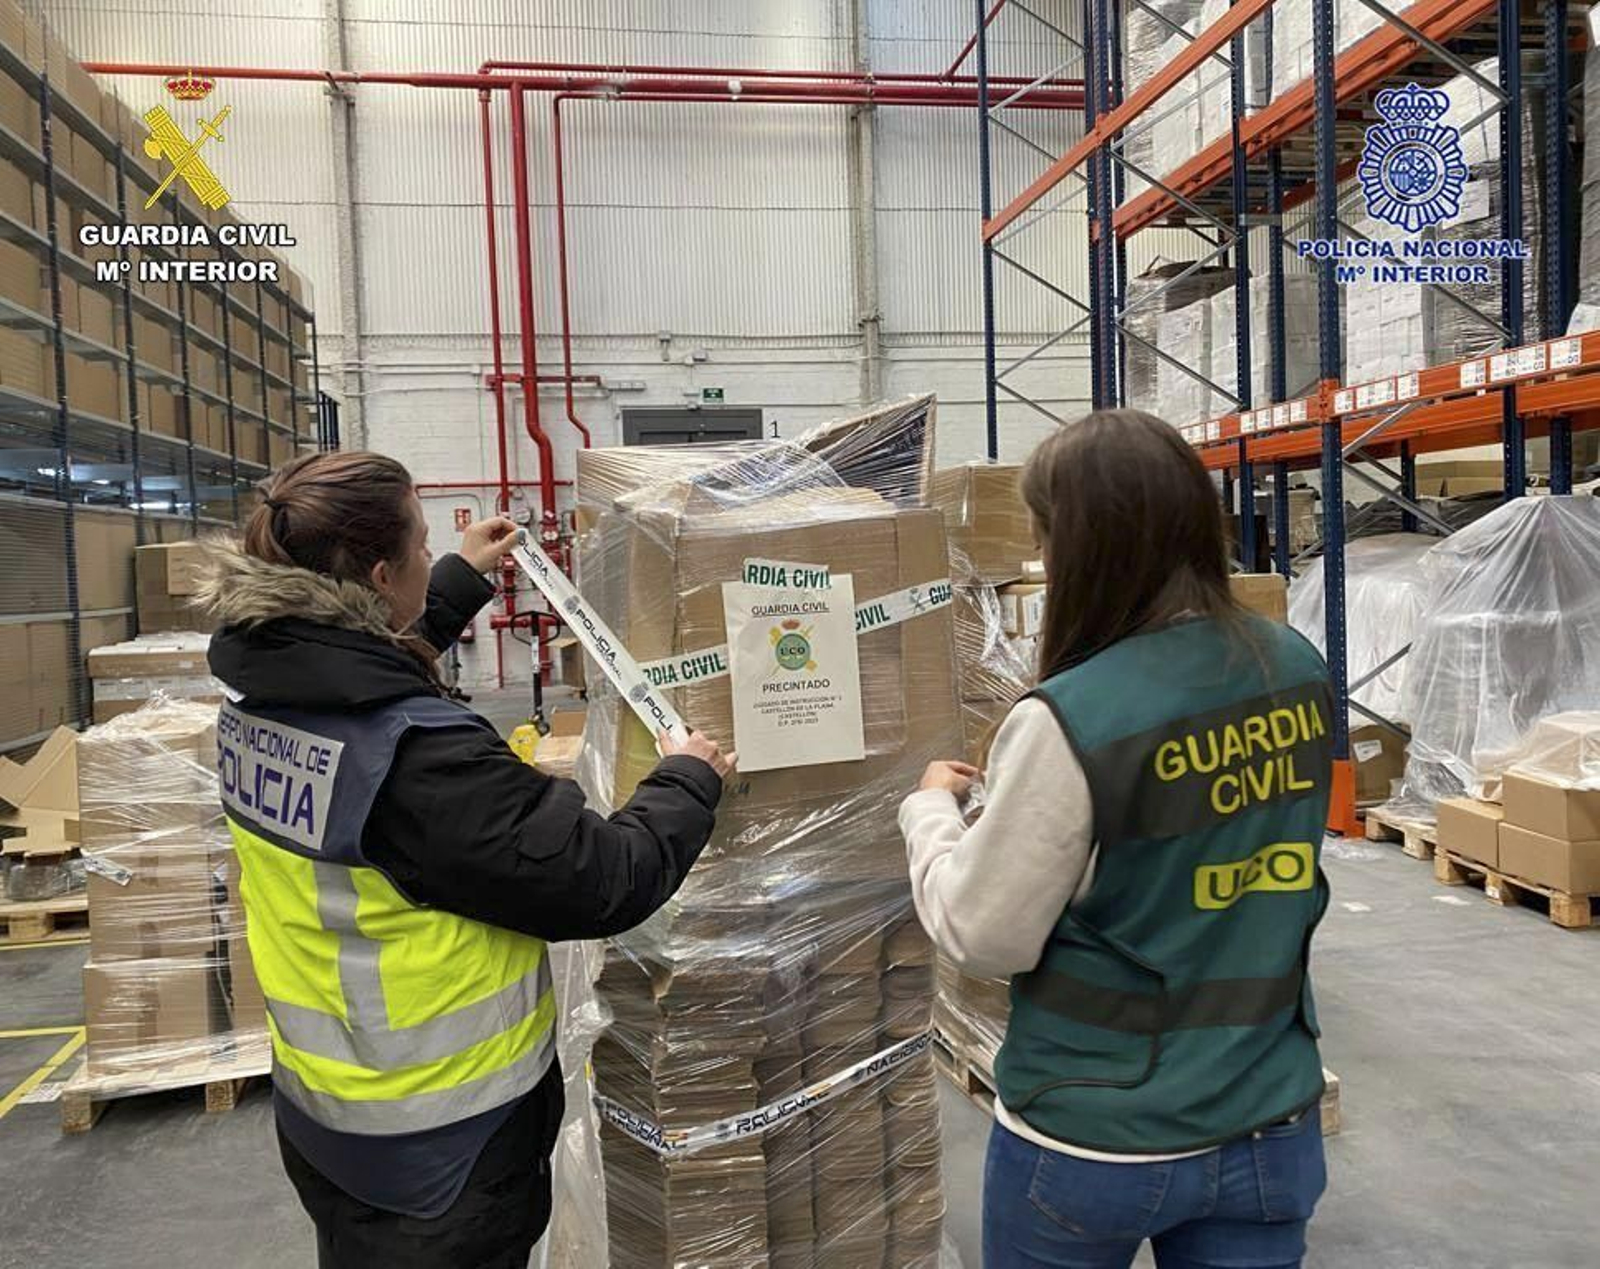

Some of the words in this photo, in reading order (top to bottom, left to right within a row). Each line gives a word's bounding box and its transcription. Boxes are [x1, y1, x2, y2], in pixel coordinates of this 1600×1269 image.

[769, 420, 781, 438] 1
[742, 564, 787, 588] RDIA
[751, 602, 800, 617] GUARDIA
[802, 601, 829, 613] CIVIL
[576, 609, 617, 661] POLICIA
[680, 652, 726, 680] CIVIL
[762, 678, 831, 694] PRECINTADO
[243, 724, 302, 768] NACIONAL
[306, 746, 331, 775] DE
[1155, 700, 1325, 781] GUARDIA
[1211, 754, 1314, 814] CIVIL
[1209, 851, 1305, 902] UCO
